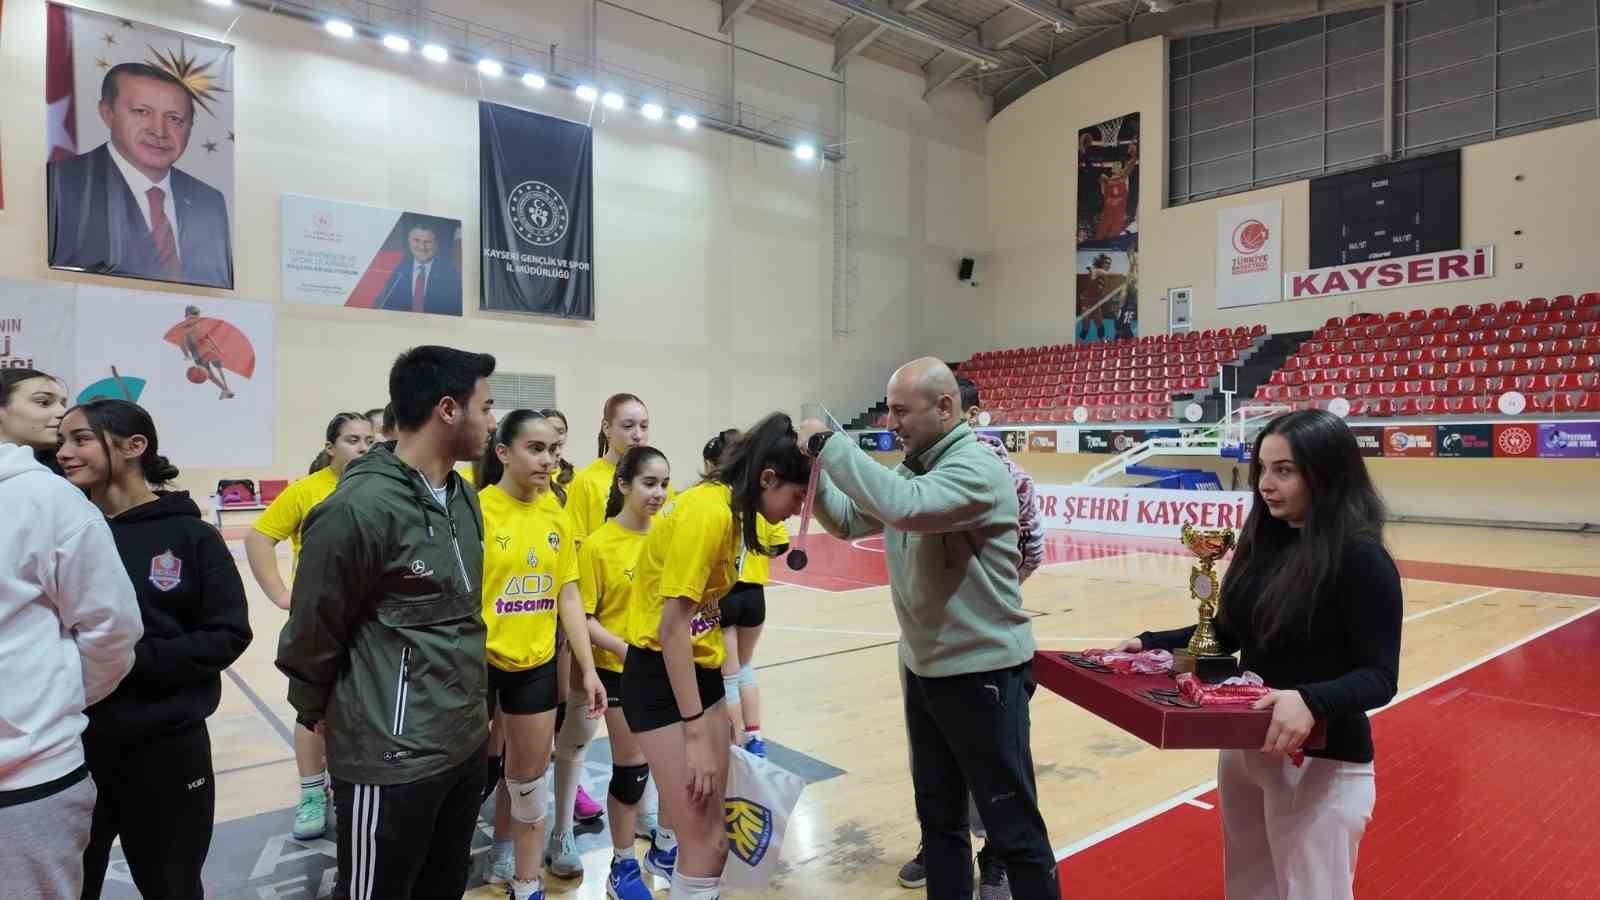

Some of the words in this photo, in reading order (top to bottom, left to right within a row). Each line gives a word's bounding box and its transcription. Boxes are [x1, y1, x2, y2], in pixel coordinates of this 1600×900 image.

[483, 248, 519, 261] KAYSERİ
[521, 254, 557, 266] GENÇLİK
[558, 258, 568, 267] VE
[569, 260, 590, 272] SPOR
[506, 262, 513, 272] İL
[515, 264, 570, 279] MÜDÜRLÜĞÜ
[1292, 248, 1486, 297] KAYSERİ
[1063, 494, 1129, 524] ŞEHRİ
[1137, 498, 1244, 529] KAYSERİ
